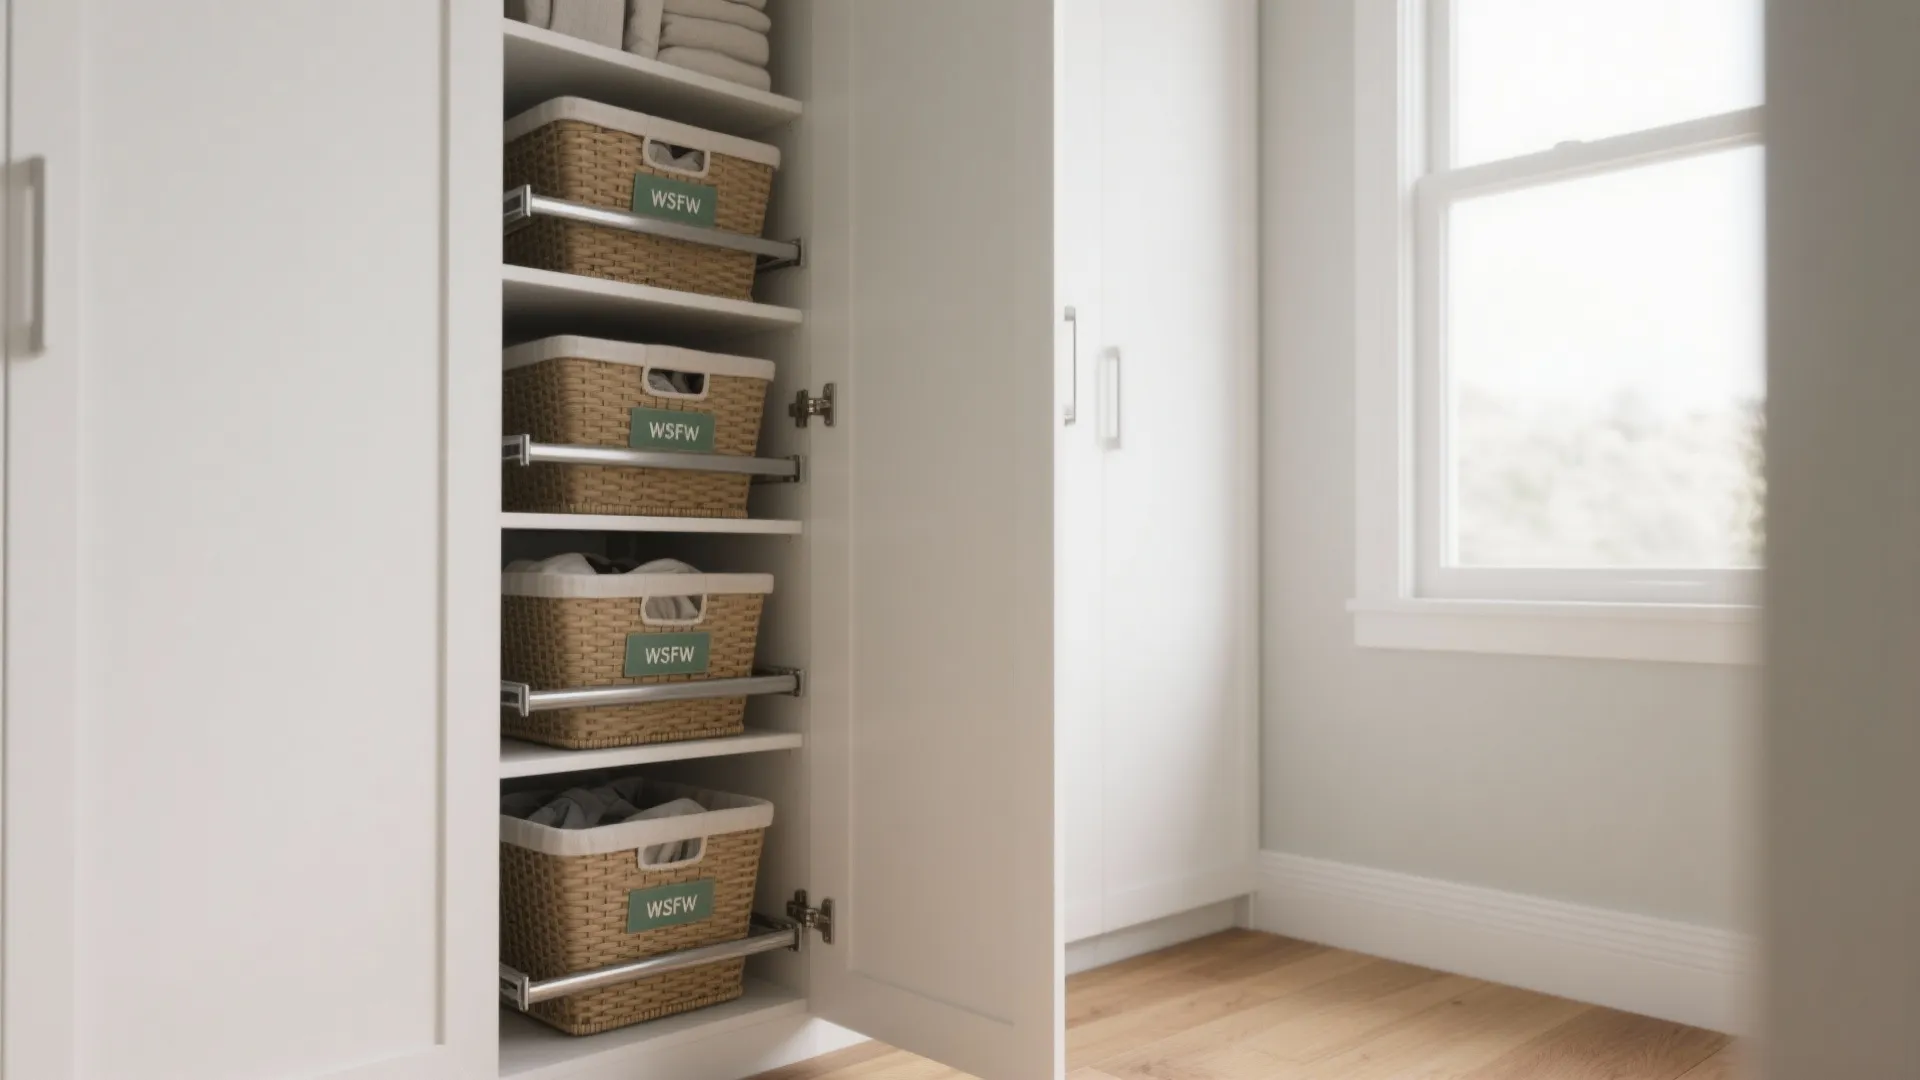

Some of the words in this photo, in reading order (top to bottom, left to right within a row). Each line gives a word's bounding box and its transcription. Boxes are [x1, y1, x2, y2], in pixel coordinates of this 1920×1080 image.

[651, 189, 701, 215] WSFW
[649, 421, 700, 441] WSFW
[645, 646, 695, 665] WSFW
[646, 895, 698, 919] WSFW
